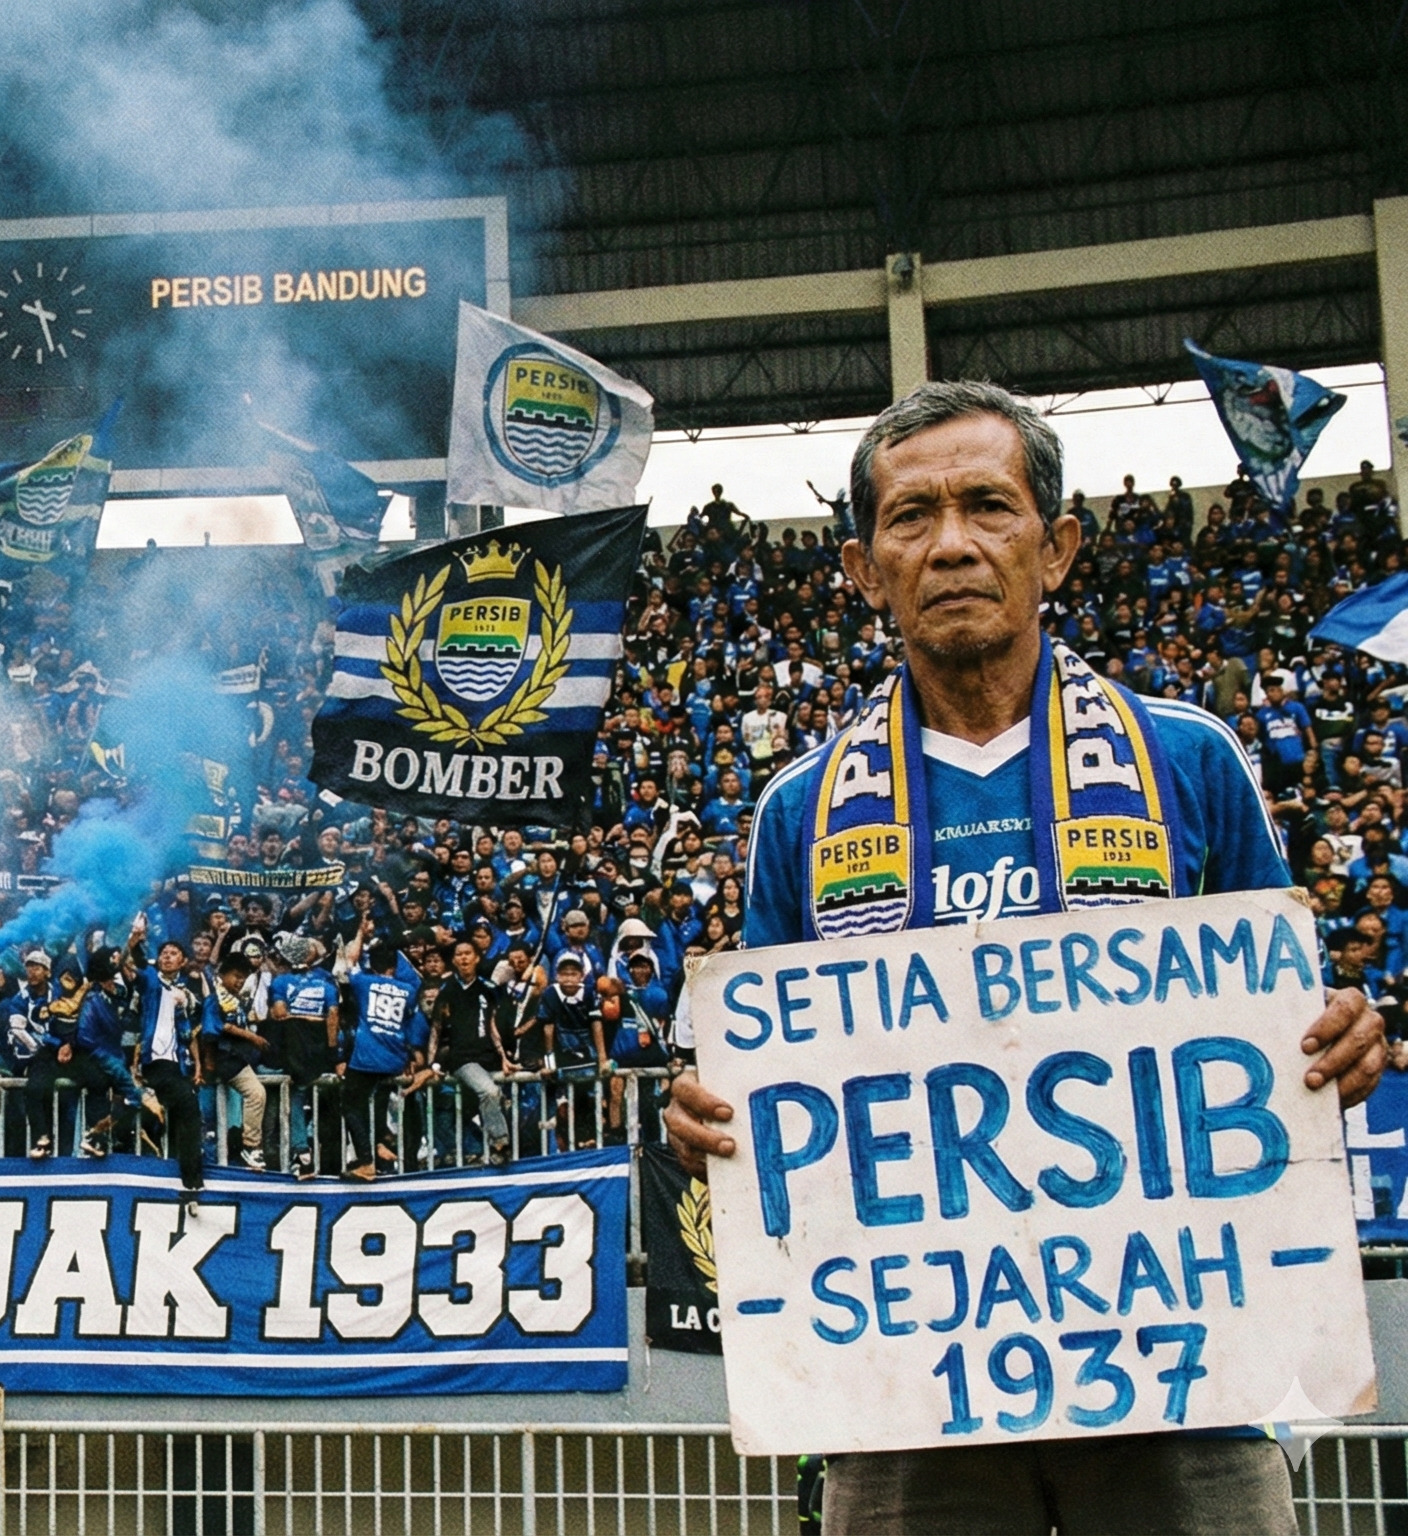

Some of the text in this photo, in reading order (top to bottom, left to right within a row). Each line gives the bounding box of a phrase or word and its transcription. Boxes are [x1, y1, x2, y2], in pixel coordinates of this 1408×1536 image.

[151, 267, 426, 308] PERSIB BANDUNG
[516, 367, 590, 394] PERSIB
[449, 605, 521, 622] PERSIB
[348, 739, 564, 801] BOMBER
[820, 834, 900, 868] PERSIB
[1067, 828, 1160, 850] PERSIB
[722, 914, 1316, 1051] SETIA BERSAMA
[749, 1036, 1292, 1238] PERSIB
[263, 1193, 593, 1339] 1933
[810, 1222, 1246, 1345] SEJARAH
[669, 1304, 702, 1330] LA
[932, 1323, 1209, 1436] 1937
